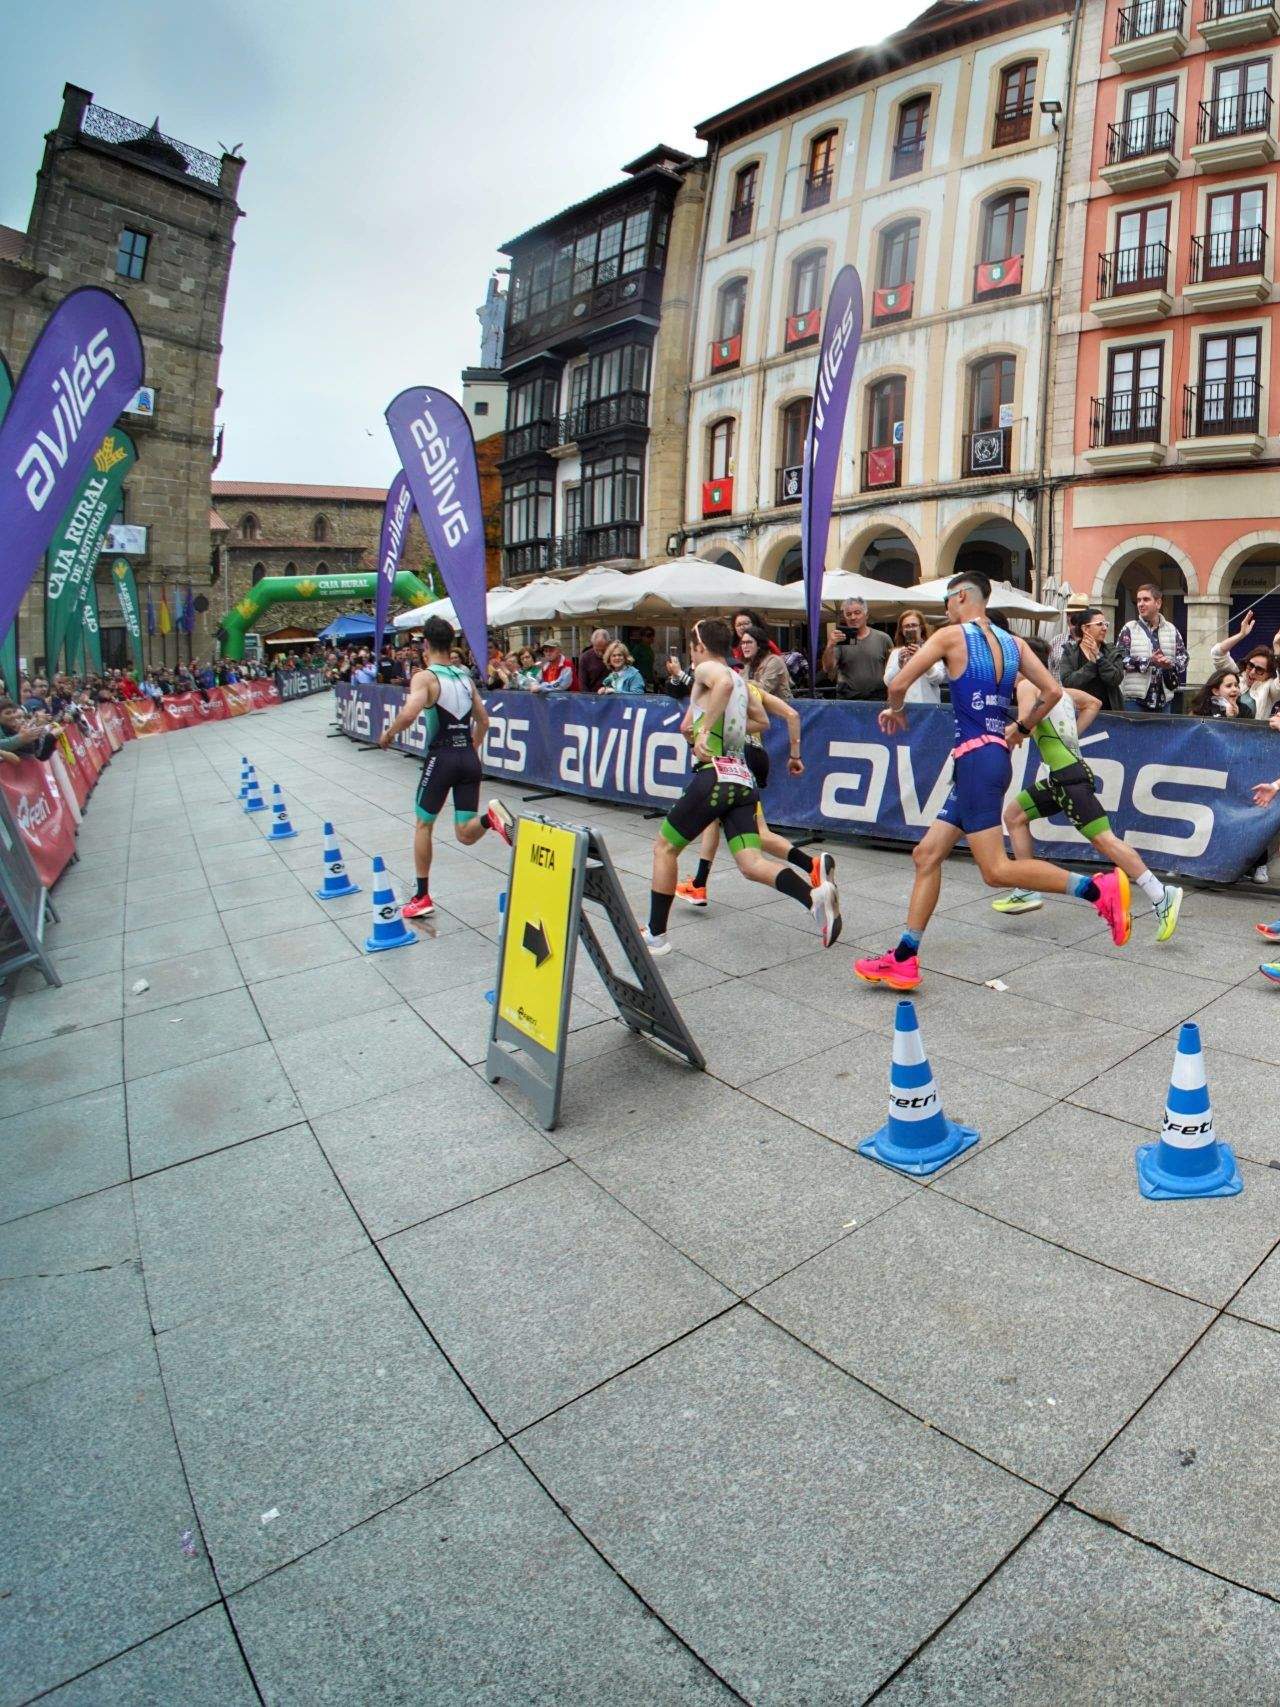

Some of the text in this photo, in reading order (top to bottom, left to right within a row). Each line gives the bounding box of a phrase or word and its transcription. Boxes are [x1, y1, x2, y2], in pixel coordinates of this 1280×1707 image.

[15, 327, 116, 512] avilés
[47, 477, 108, 600] CAJA RURAL
[70, 501, 108, 584] DE ASTURIAS
[383, 484, 411, 583] avilés
[319, 579, 369, 589] CAJA RURAL
[559, 707, 689, 800] avilé
[530, 843, 555, 871] META
